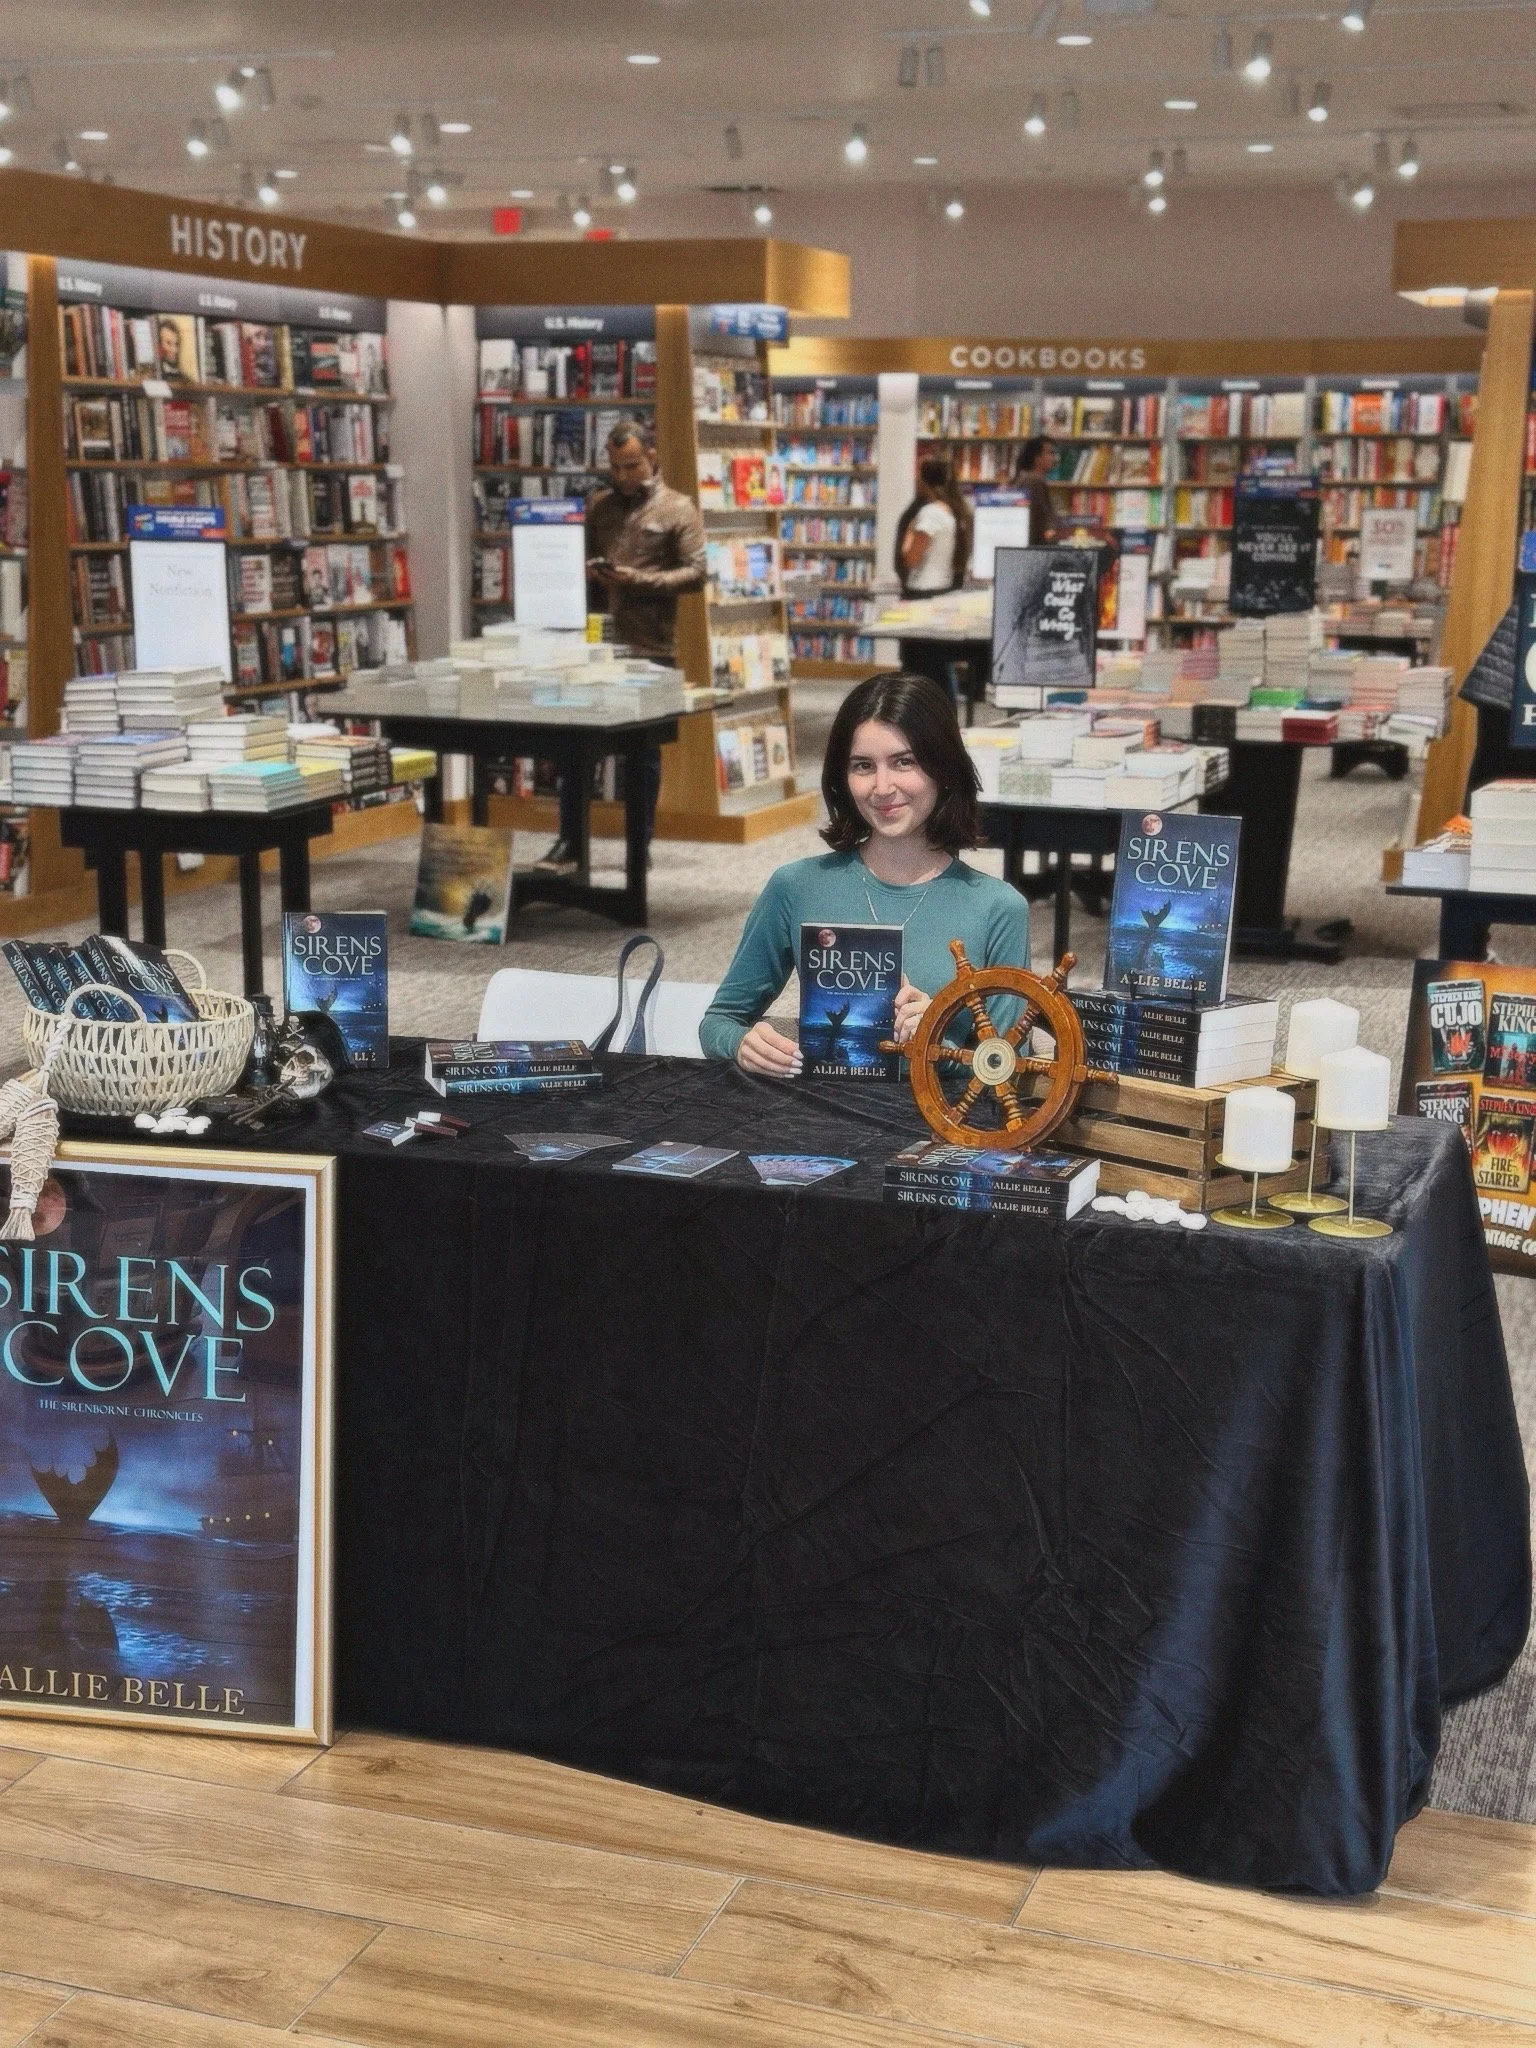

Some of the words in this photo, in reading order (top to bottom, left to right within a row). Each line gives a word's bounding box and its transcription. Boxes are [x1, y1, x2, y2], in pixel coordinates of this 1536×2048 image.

[170, 214, 308, 270] HISTORY
[950, 345, 1146, 370] COOKBOOKS
[1237, 542, 1275, 553] NEVER
[1277, 542, 1298, 553] SEE
[167, 565, 192, 577] New
[150, 584, 213, 597] Nonfiction
[1051, 580, 1085, 594] What
[1044, 592, 1077, 607] Could
[1058, 607, 1077, 622] Go
[1127, 837, 1230, 867] SIRENS
[1135, 861, 1220, 890] COVE
[294, 935, 382, 956] SIRENS
[89, 949, 110, 981] SIRENS
[303, 955, 374, 976] COVE
[809, 949, 896, 972] SIRENS
[10, 954, 34, 988] SIRENS
[33, 957, 56, 991] SIRENS
[54, 962, 76, 994] SIREN
[128, 973, 181, 996] COVE
[816, 969, 887, 991] COVE
[1120, 973, 1160, 988] ALIE
[1164, 977, 1207, 992] BELE
[1102, 1003, 1127, 1016] COVE
[1143, 1011, 1163, 1021] ALLIE
[1165, 1014, 1187, 1025] BELLE
[1431, 1001, 1483, 1029] CUJO
[1492, 1001, 1536, 1018] STEPHE
[1100, 1022, 1125, 1035] COVE
[1497, 1015, 1536, 1035] KING
[1140, 1030, 1161, 1040] ALLIE
[1162, 1034, 1184, 1044] BELLE
[1098, 1040, 1123, 1053] COVE
[1138, 1048, 1159, 1059] ALLIE
[1160, 1052, 1182, 1063] BELLE
[445, 1065, 480, 1076] SIRENS
[482, 1064, 510, 1075] COVE
[528, 1065, 551, 1073] ALLIE
[553, 1064, 577, 1072] BELLE
[813, 1065, 847, 1076] ALLIE
[850, 1066, 886, 1077] BELLE
[1095, 1059, 1120, 1072] COVE
[1136, 1067, 1157, 1078] ALLIE
[1158, 1071, 1181, 1082] BELLE
[458, 1083, 493, 1094] SIRENS
[495, 1082, 522, 1092] COVE
[540, 1081, 563, 1089] ALLIE
[564, 1079, 588, 1088] BELLE
[1419, 1097, 1470, 1112] STEPHEN
[1479, 1099, 1514, 1112] STEPHEN
[1426, 1108, 1464, 1125] KING
[900, 1171, 939, 1185] SIRENS
[941, 1175, 973, 1188] COVE
[993, 1180, 1020, 1192] ALLIE
[1022, 1183, 1050, 1195] BELLE
[1477, 1170, 1520, 1189] STARTER
[897, 1190, 937, 1206] SIRENS
[939, 1194, 972, 1208] COVE
[992, 1202, 1019, 1213] ALLIE
[1020, 1204, 1049, 1215] BELLE
[3, 1320, 246, 1402] COVE
[39, 1399, 60, 1411] THE
[62, 1401, 131, 1417] SIRENBORNE
[133, 1407, 204, 1422] CHRONICLES
[0, 1664, 109, 1701] ALLIE
[123, 1677, 246, 1716] BELLE
